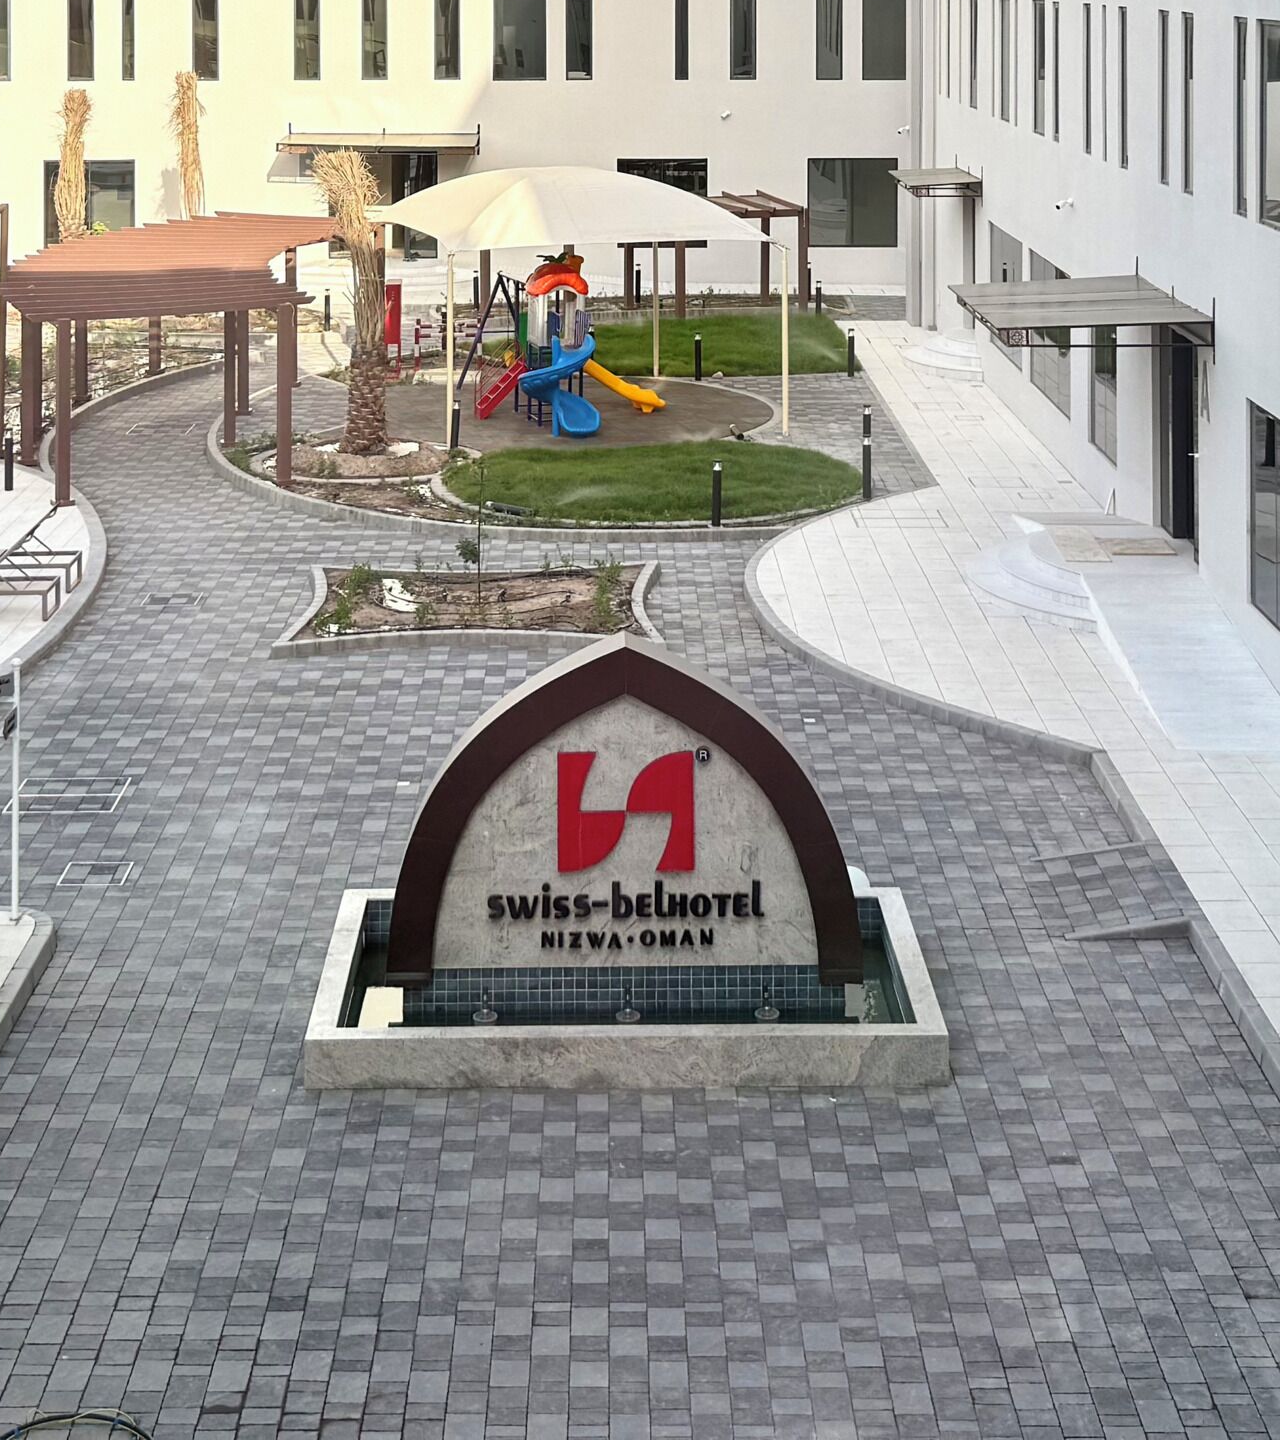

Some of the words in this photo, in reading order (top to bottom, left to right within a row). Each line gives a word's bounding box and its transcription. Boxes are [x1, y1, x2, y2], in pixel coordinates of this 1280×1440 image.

[1200, 359, 1211, 424] A
[541, 930, 623, 950] NIZWA
[639, 927, 714, 948] OMAN
